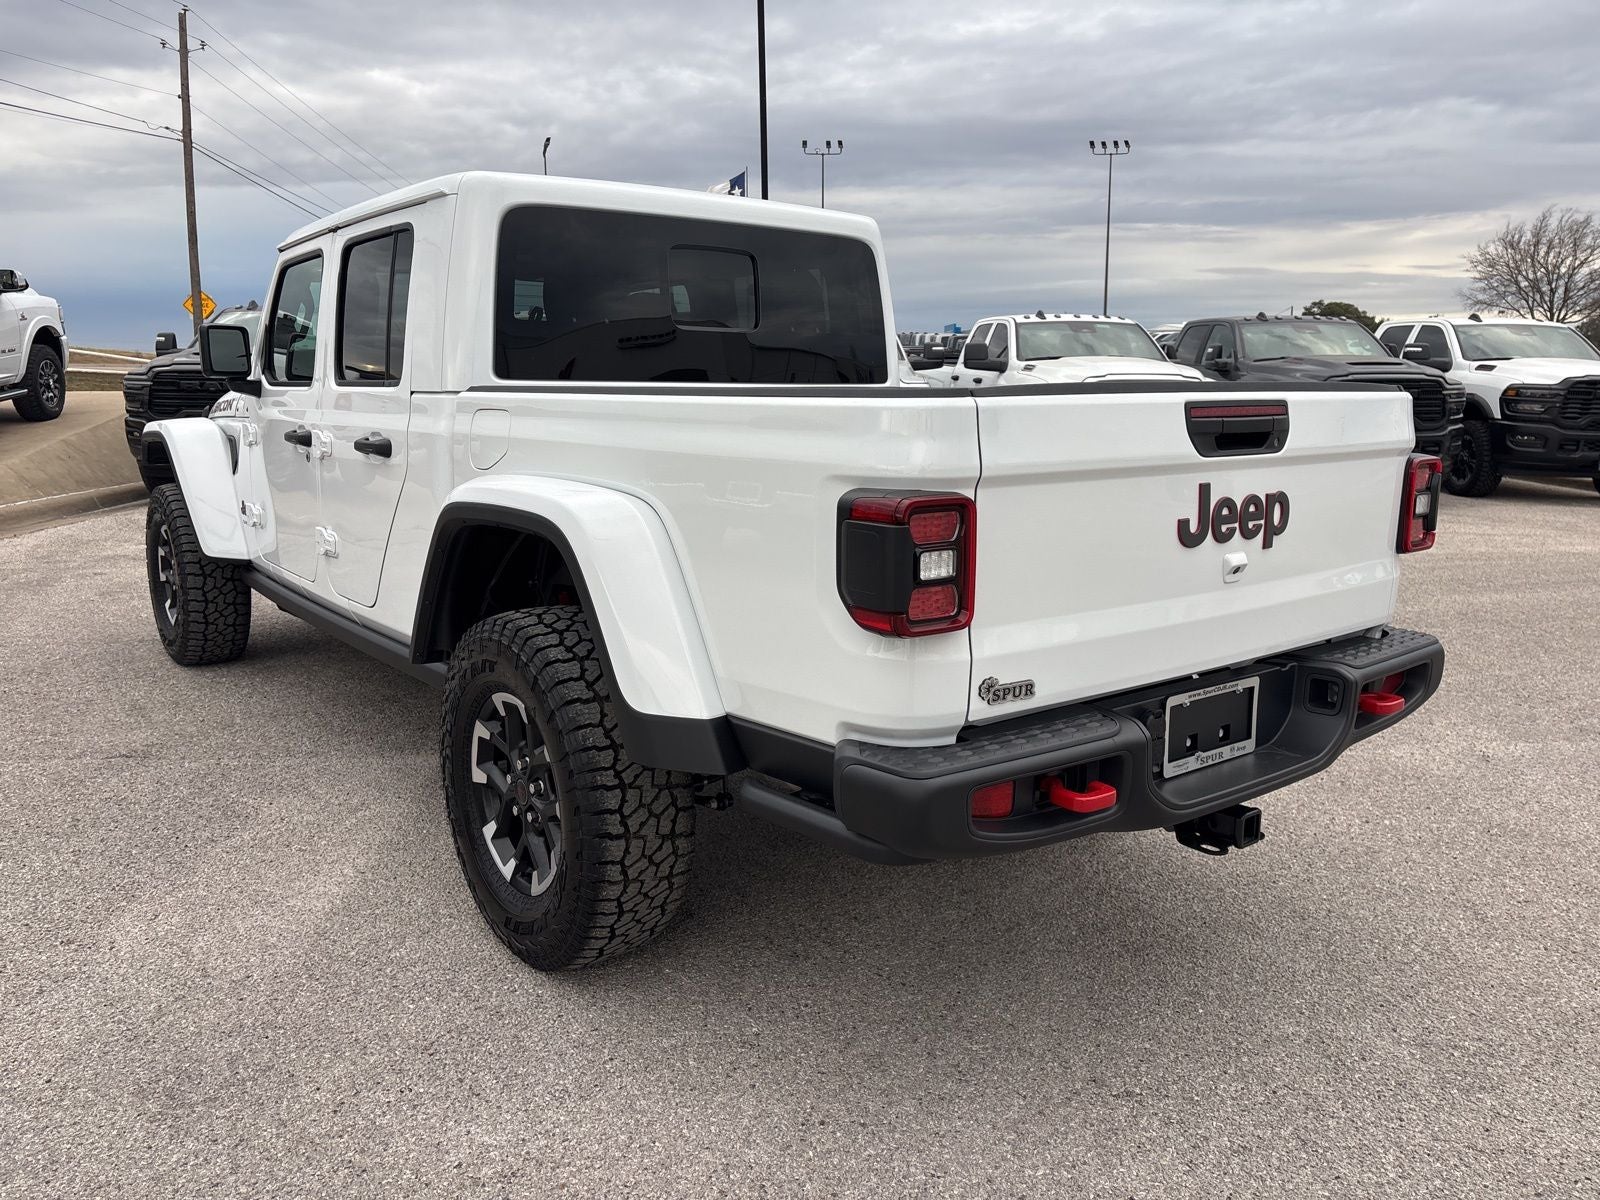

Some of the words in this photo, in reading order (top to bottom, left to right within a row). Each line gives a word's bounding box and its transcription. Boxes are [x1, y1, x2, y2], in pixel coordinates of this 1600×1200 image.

[1177, 482, 1290, 550] Jeep
[992, 683, 1034, 702] SPUR
[1199, 751, 1224, 765] SPUR
